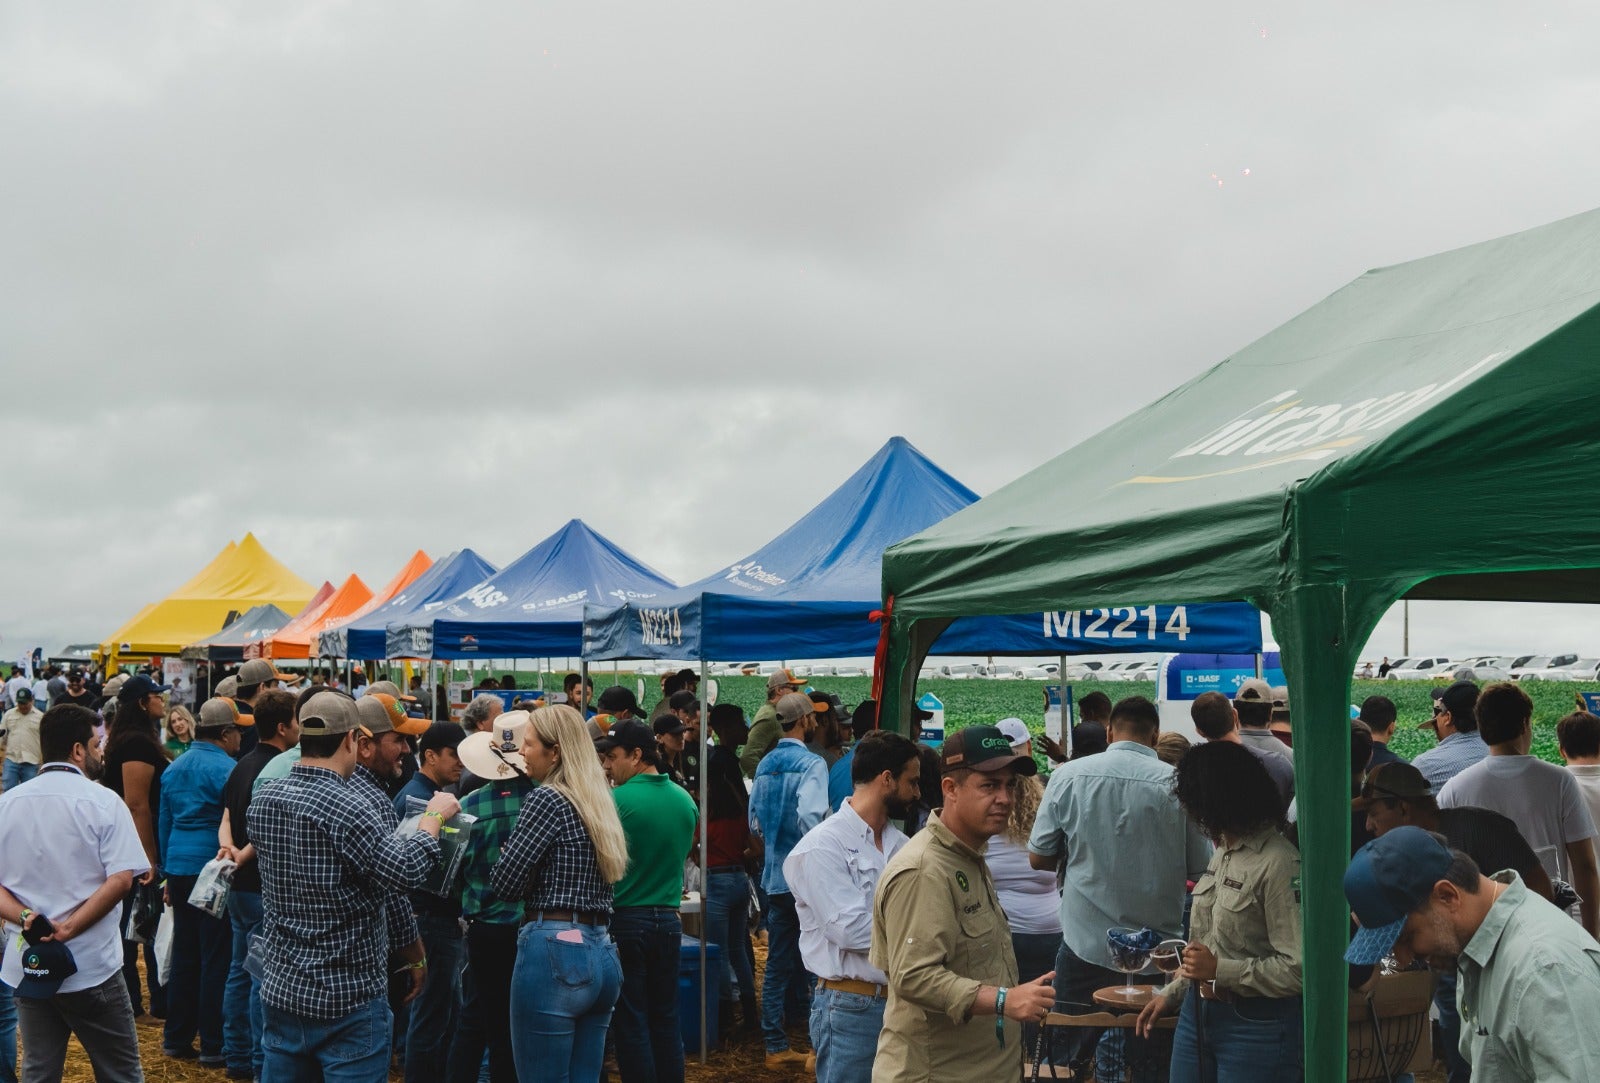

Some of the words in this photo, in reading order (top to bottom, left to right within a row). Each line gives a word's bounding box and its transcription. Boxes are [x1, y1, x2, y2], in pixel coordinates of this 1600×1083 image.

[638, 607, 683, 646] M2214
[1043, 605, 1191, 641] M2214
[1198, 675, 1220, 683] BASF
